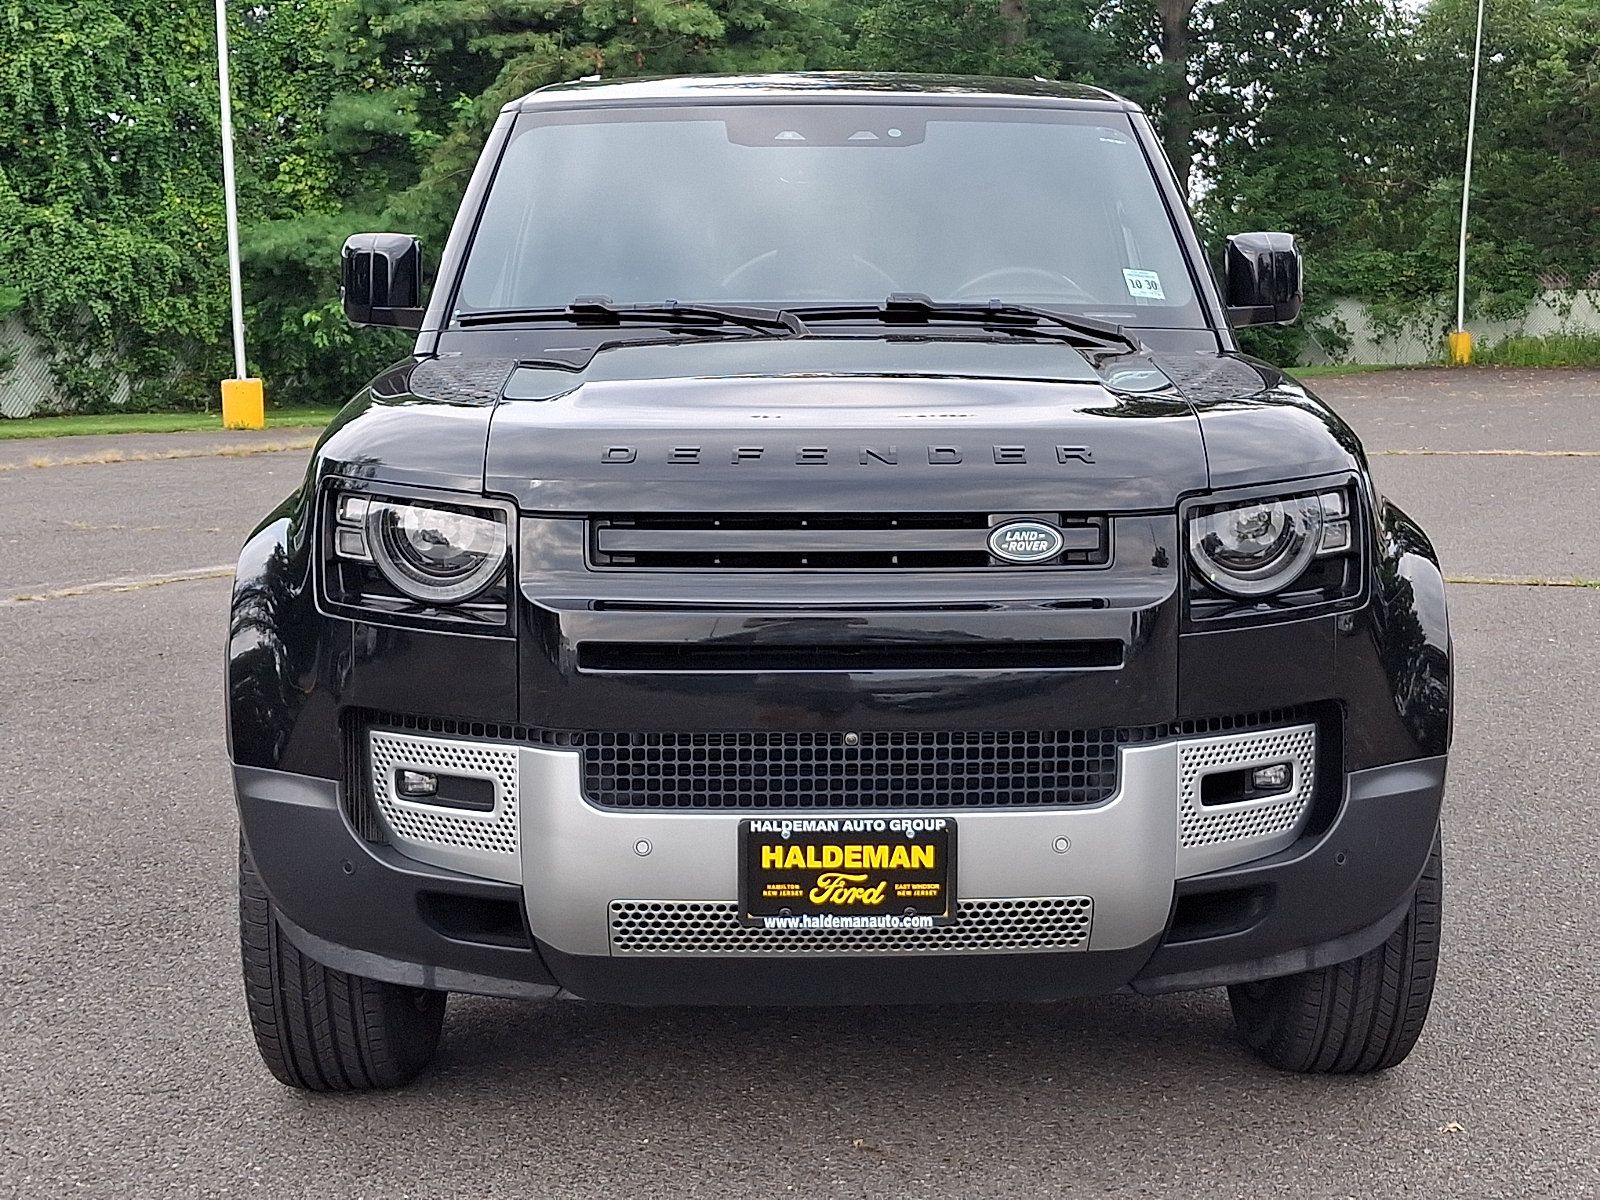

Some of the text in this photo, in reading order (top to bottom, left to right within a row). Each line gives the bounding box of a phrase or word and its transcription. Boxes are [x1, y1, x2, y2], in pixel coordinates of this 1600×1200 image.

[1129, 279, 1142, 289] 10
[600, 445, 1096, 465] DEFENDER
[750, 819, 946, 832] HALDEMAN AUTO GROUP
[761, 845, 934, 868] HALDEMAN
[809, 872, 887, 904] Ford
[764, 914, 933, 928] www.haldemanauto.com
